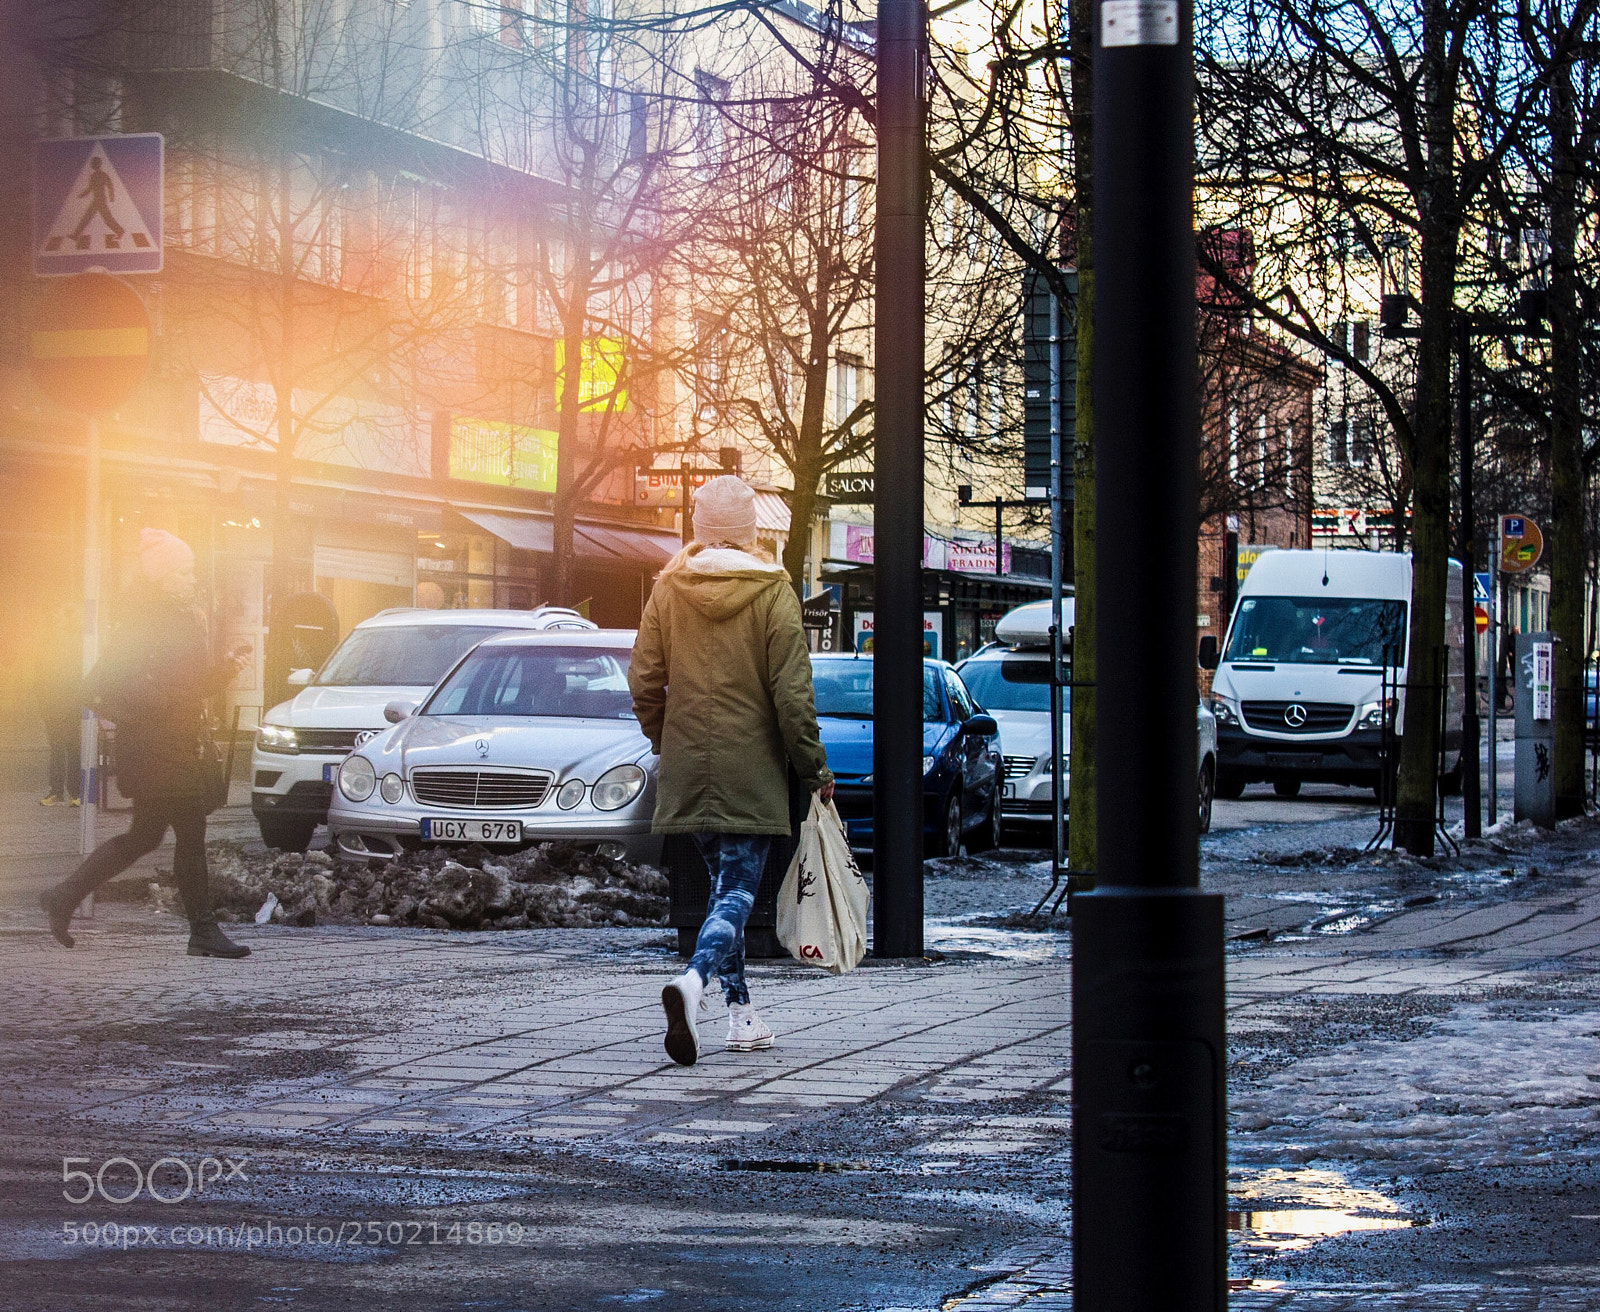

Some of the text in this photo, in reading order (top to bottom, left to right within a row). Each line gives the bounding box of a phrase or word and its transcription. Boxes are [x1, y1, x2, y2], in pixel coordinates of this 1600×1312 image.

[1511, 520, 1519, 531] P
[952, 559, 1004, 567] TRADIN
[433, 821, 517, 840] UGX 678
[799, 944, 824, 959] ICA
